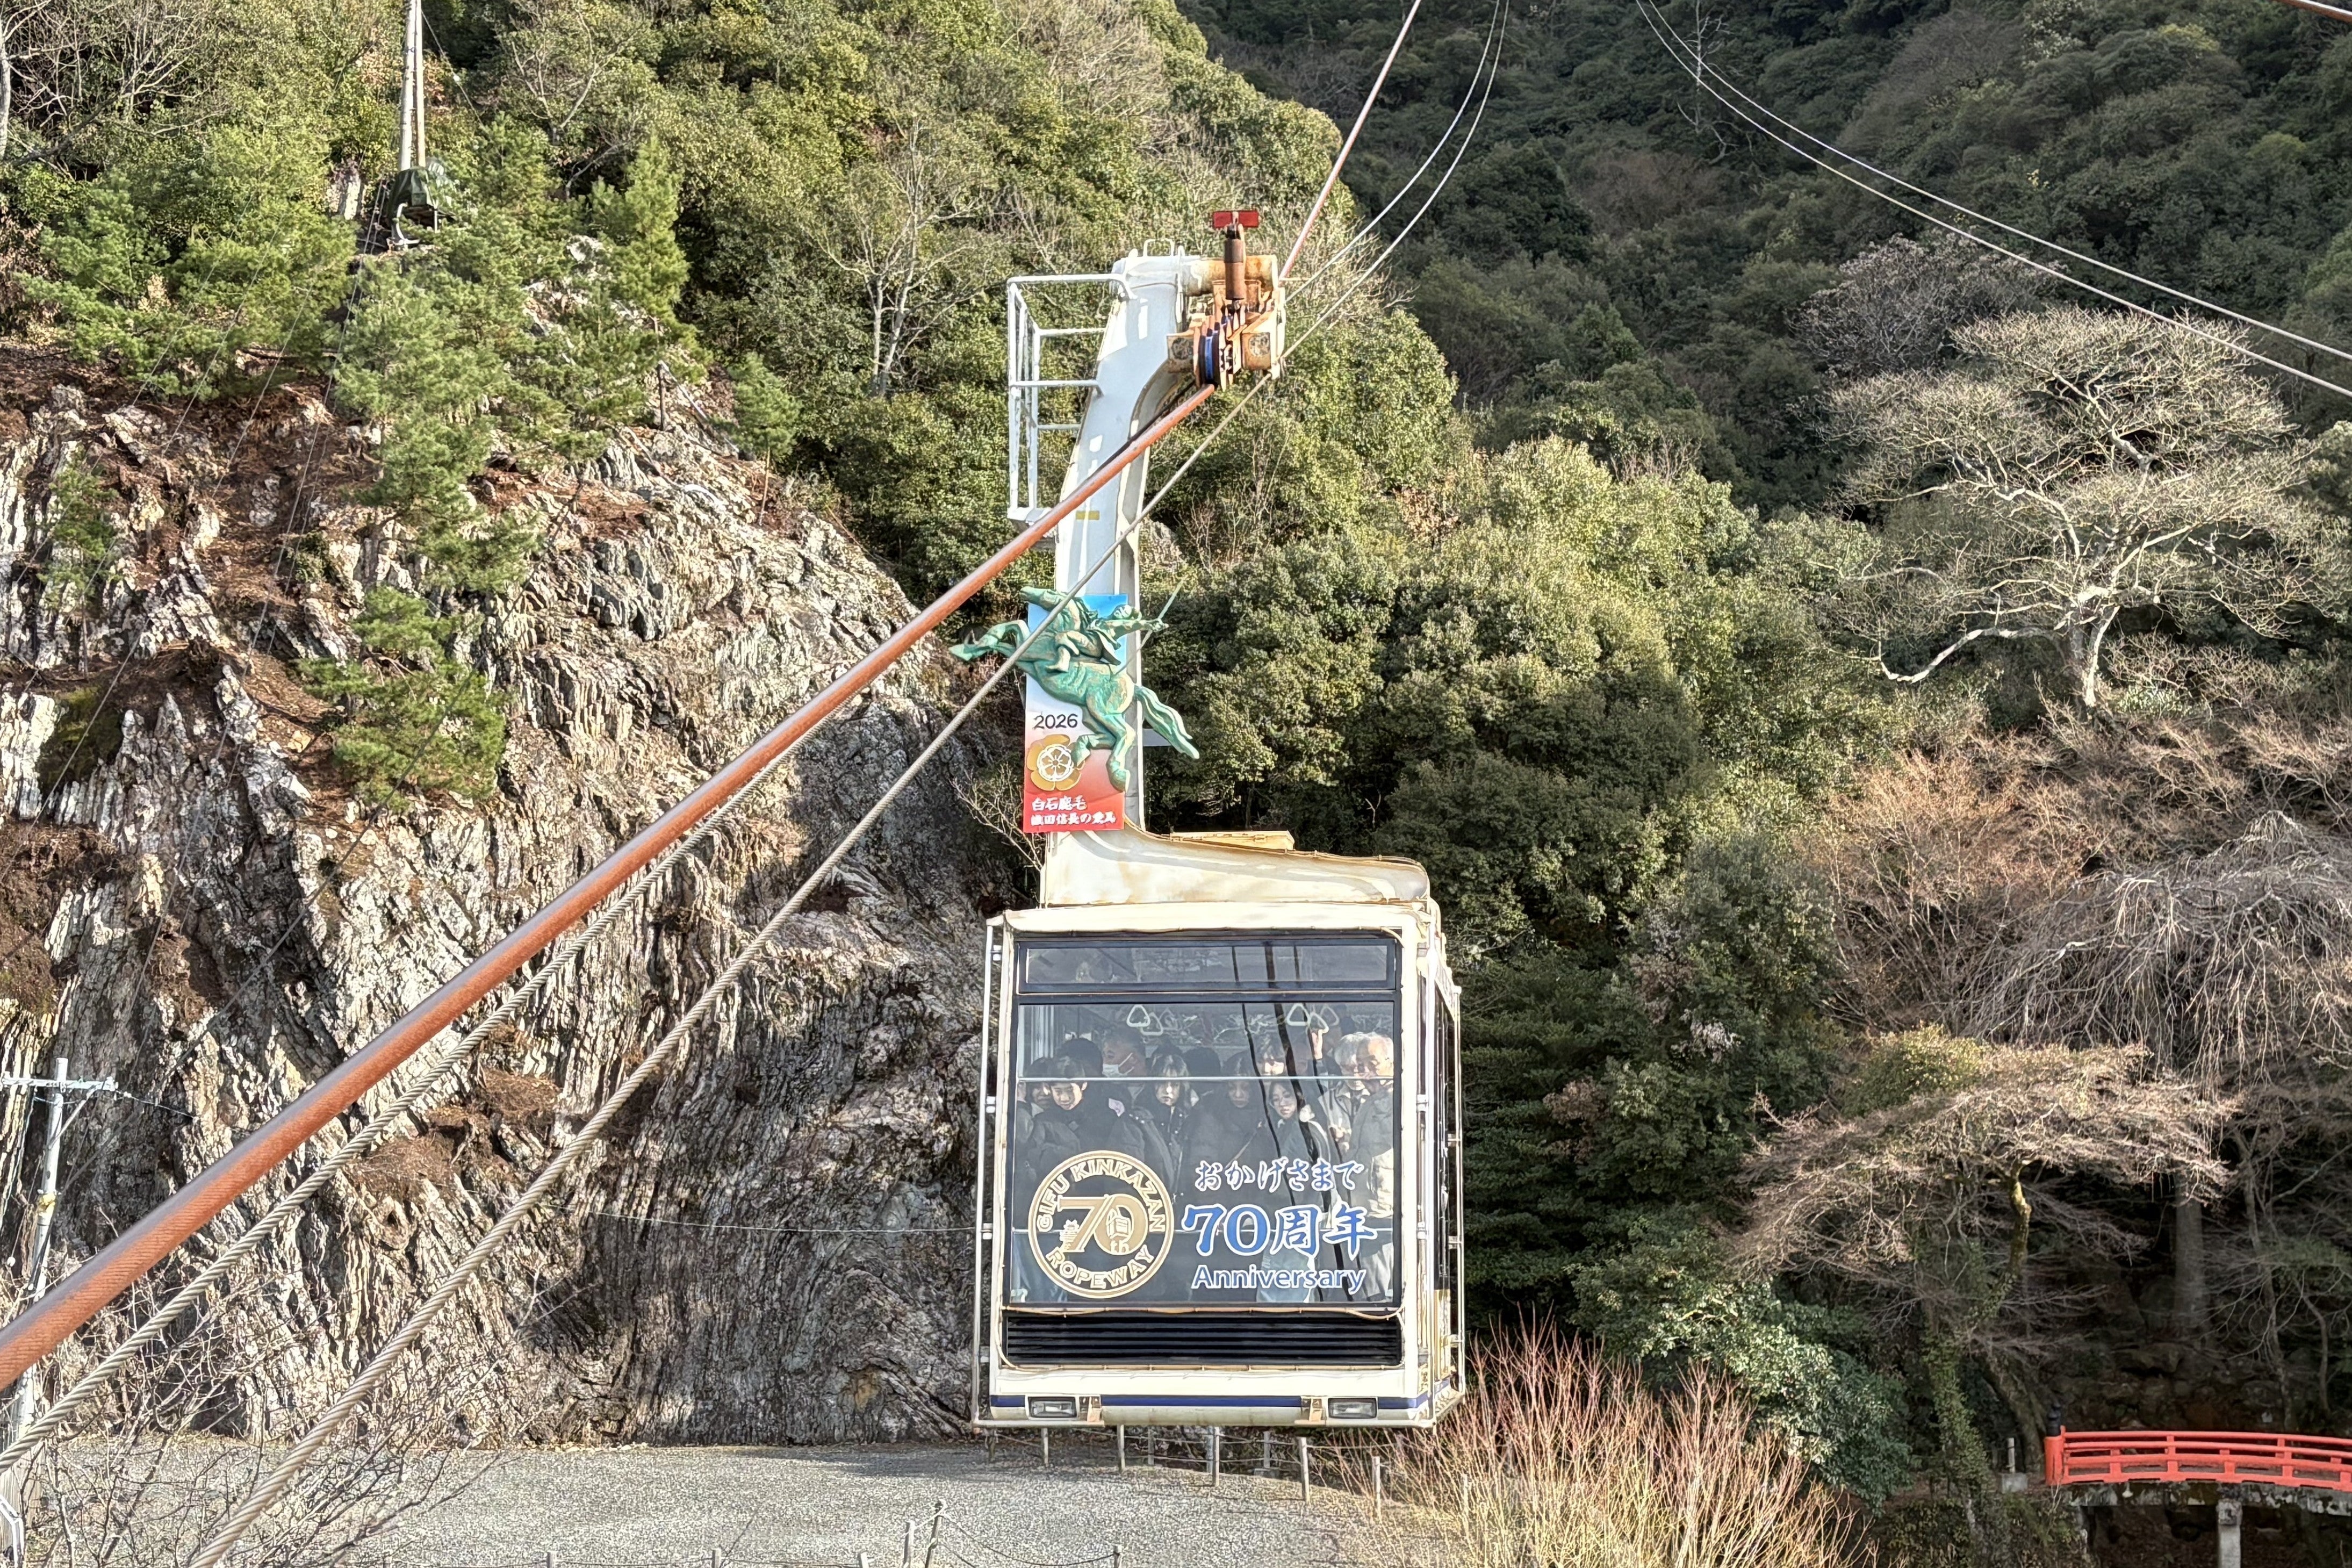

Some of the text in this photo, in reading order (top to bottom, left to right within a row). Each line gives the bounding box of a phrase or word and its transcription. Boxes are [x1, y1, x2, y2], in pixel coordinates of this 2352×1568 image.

[1033, 713, 1078, 729] 2026
[1195, 1156, 1364, 1193] おかげさまで
[1037, 1159, 1166, 1232] GIFU KINKAZAN
[1182, 1201, 1378, 1261] 70周年
[1045, 1245, 1154, 1289] ROPEWAY
[1191, 1264, 1366, 1295] Anniversary
